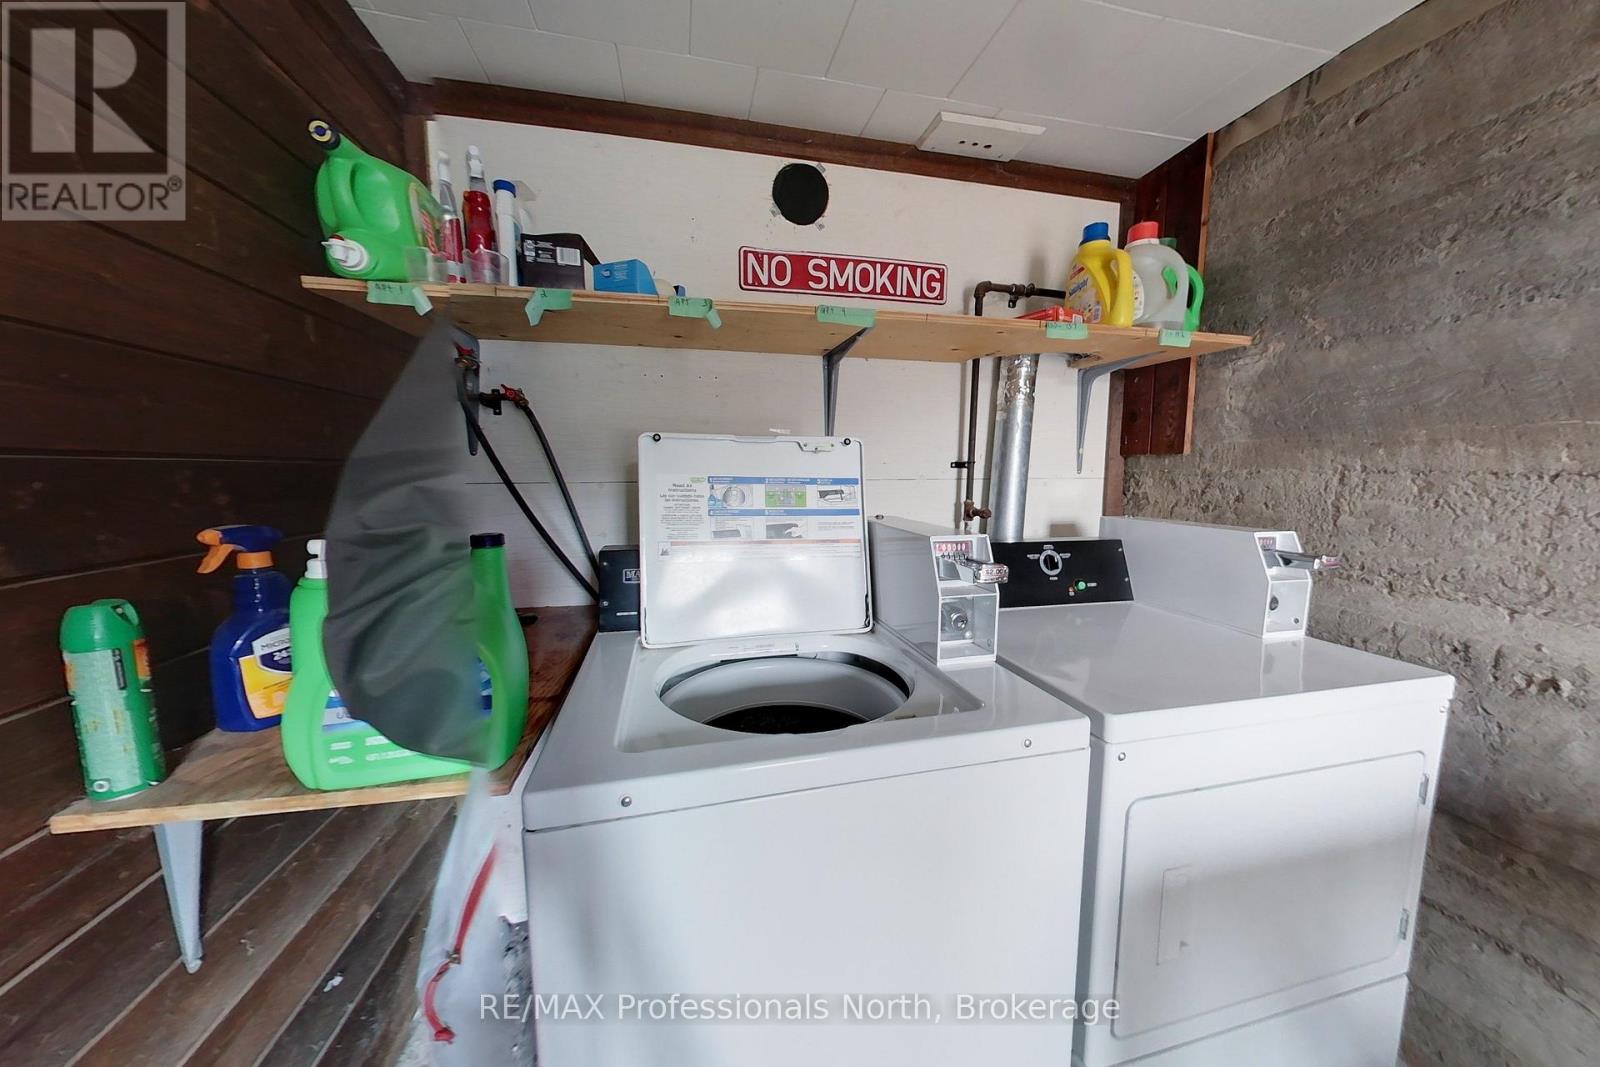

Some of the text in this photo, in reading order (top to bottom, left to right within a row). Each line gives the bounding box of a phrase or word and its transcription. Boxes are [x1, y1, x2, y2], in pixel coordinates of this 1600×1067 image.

[747, 252, 942, 298] NO SMOKING
[540, 288, 548, 298] 2
